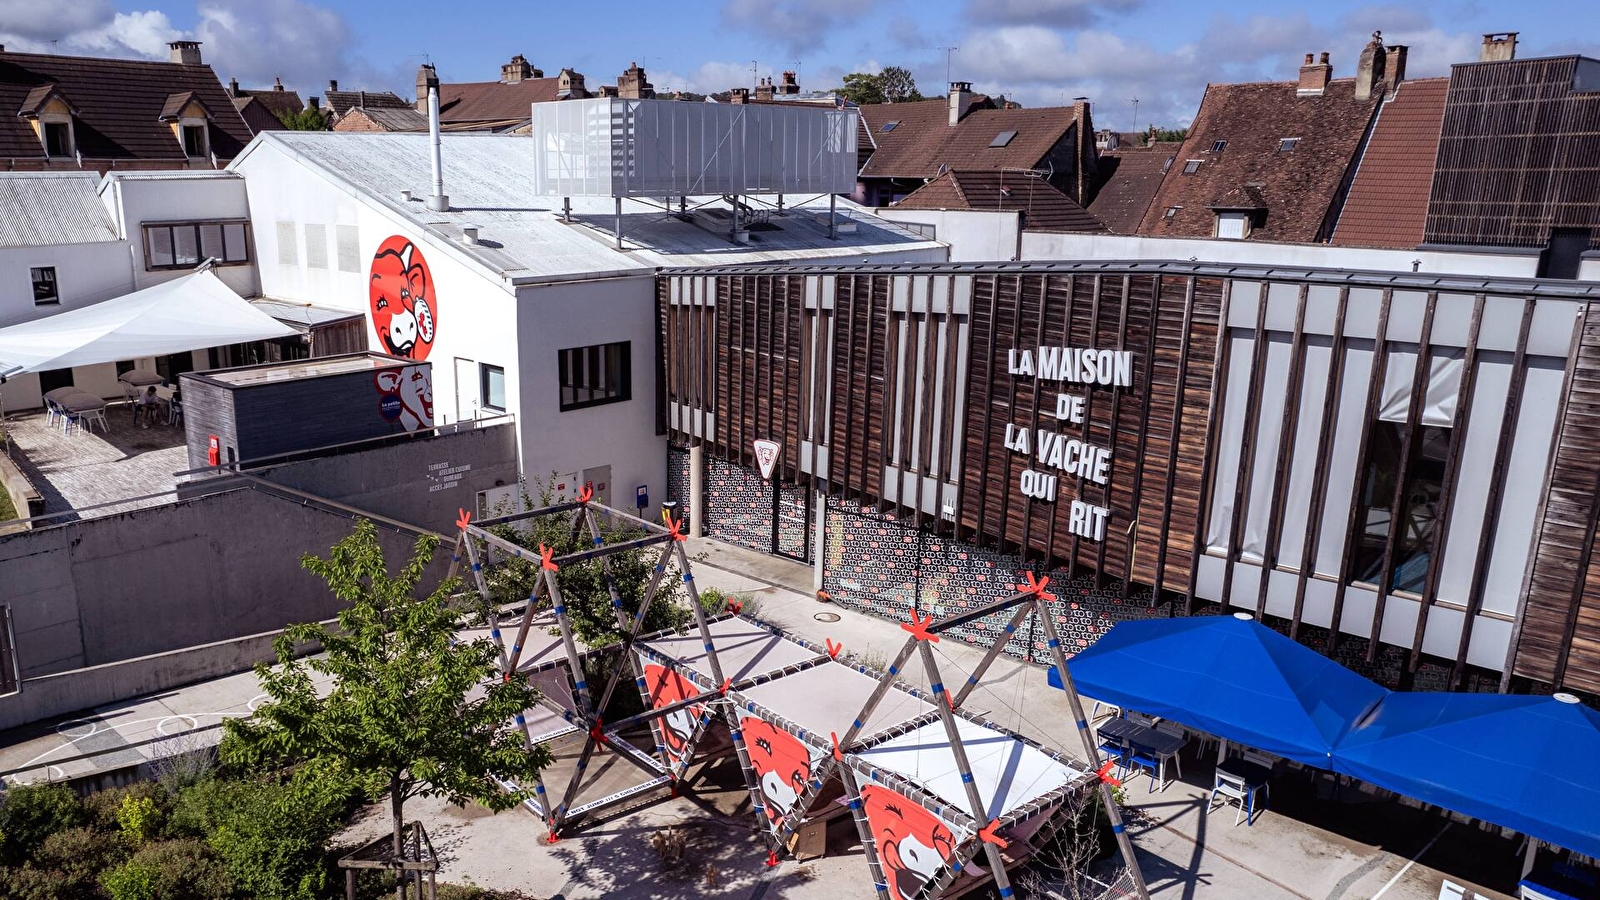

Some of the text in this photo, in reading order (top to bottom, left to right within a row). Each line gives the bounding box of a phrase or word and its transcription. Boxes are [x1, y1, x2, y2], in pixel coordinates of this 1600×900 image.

[1009, 346, 1133, 386] LA MAISON
[1057, 393, 1085, 424] DE
[428, 462, 449, 471] TERRASSE
[1004, 423, 1113, 485] LA VACHE
[439, 464, 471, 476] ATELIER CUISINE
[443, 481, 458, 489] JARDIN
[1020, 469, 1110, 541] QUI RIT
[587, 799, 604, 809] JUMP
[620, 783, 651, 797] CHILDREN
